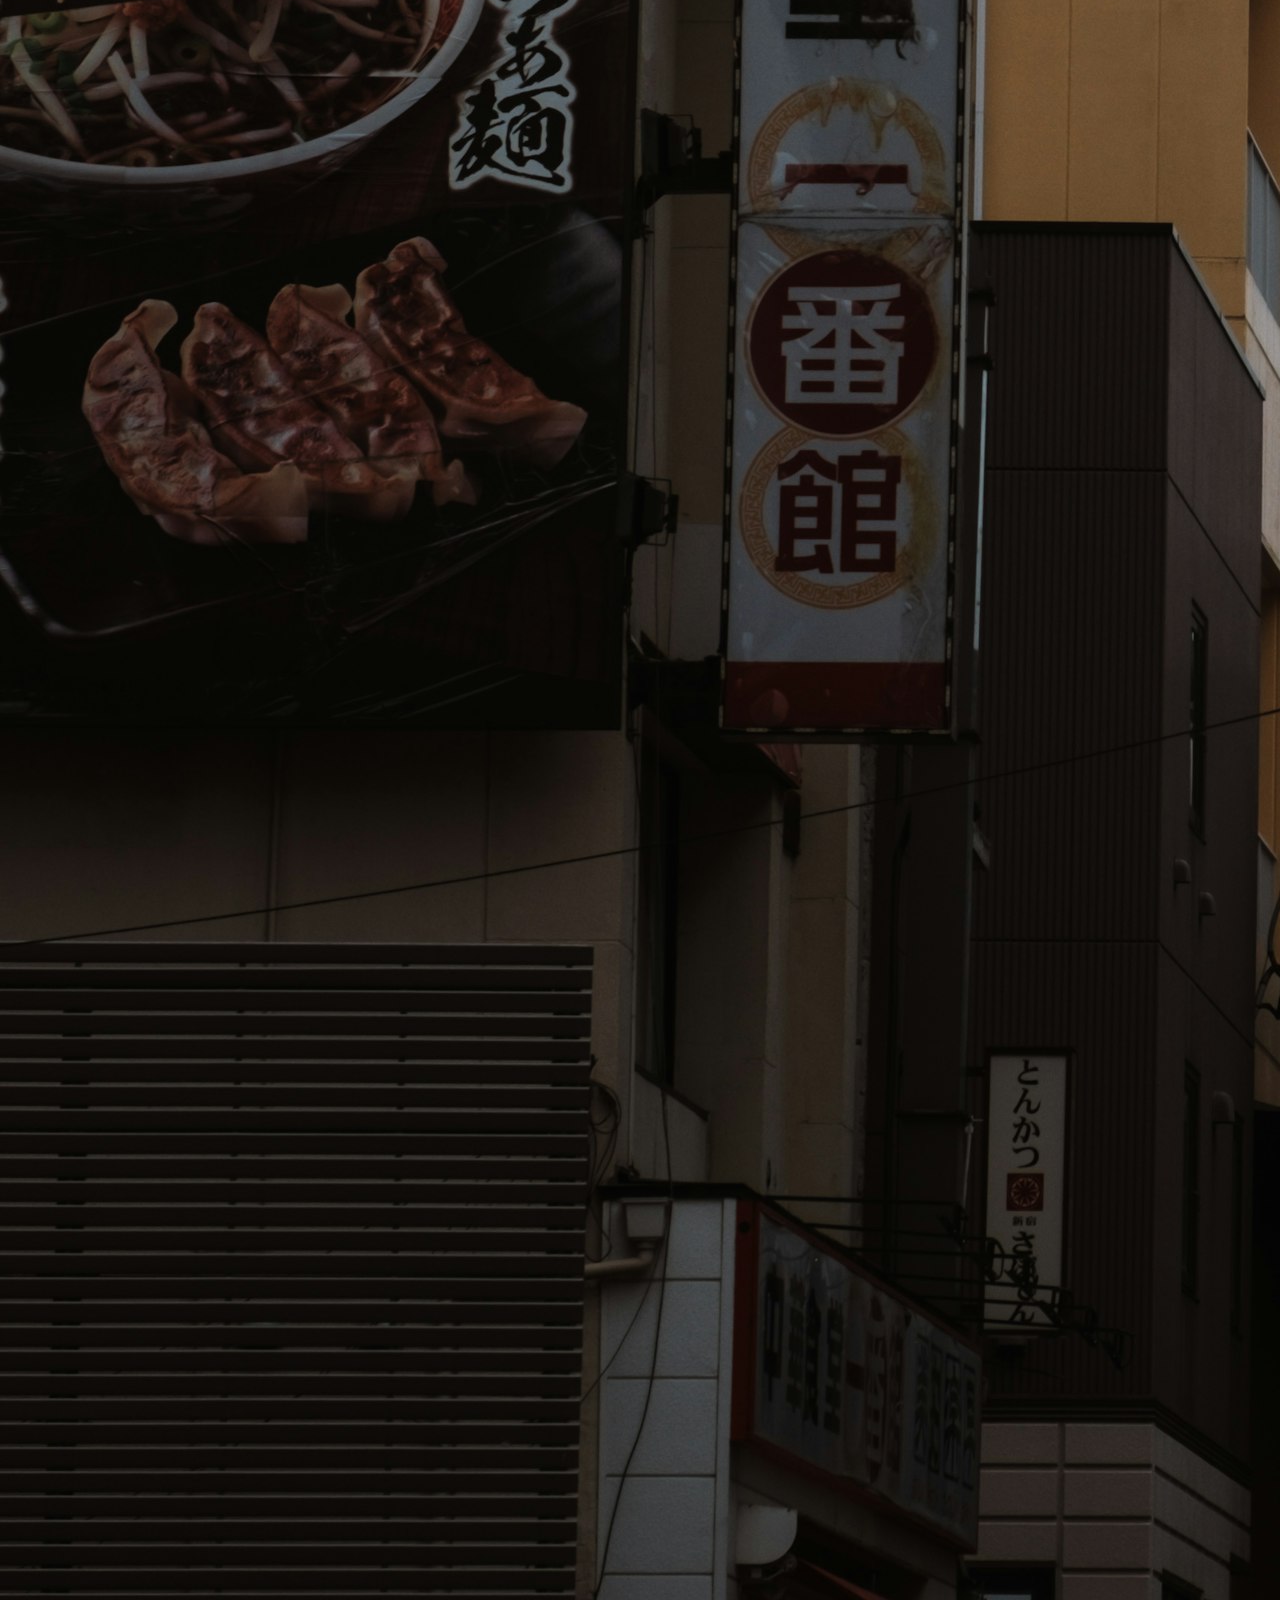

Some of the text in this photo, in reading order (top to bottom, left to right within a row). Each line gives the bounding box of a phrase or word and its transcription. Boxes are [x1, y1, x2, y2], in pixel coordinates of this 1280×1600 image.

[774, 163, 909, 574] 一番館
[1012, 1058, 1041, 1169] とんかつ
